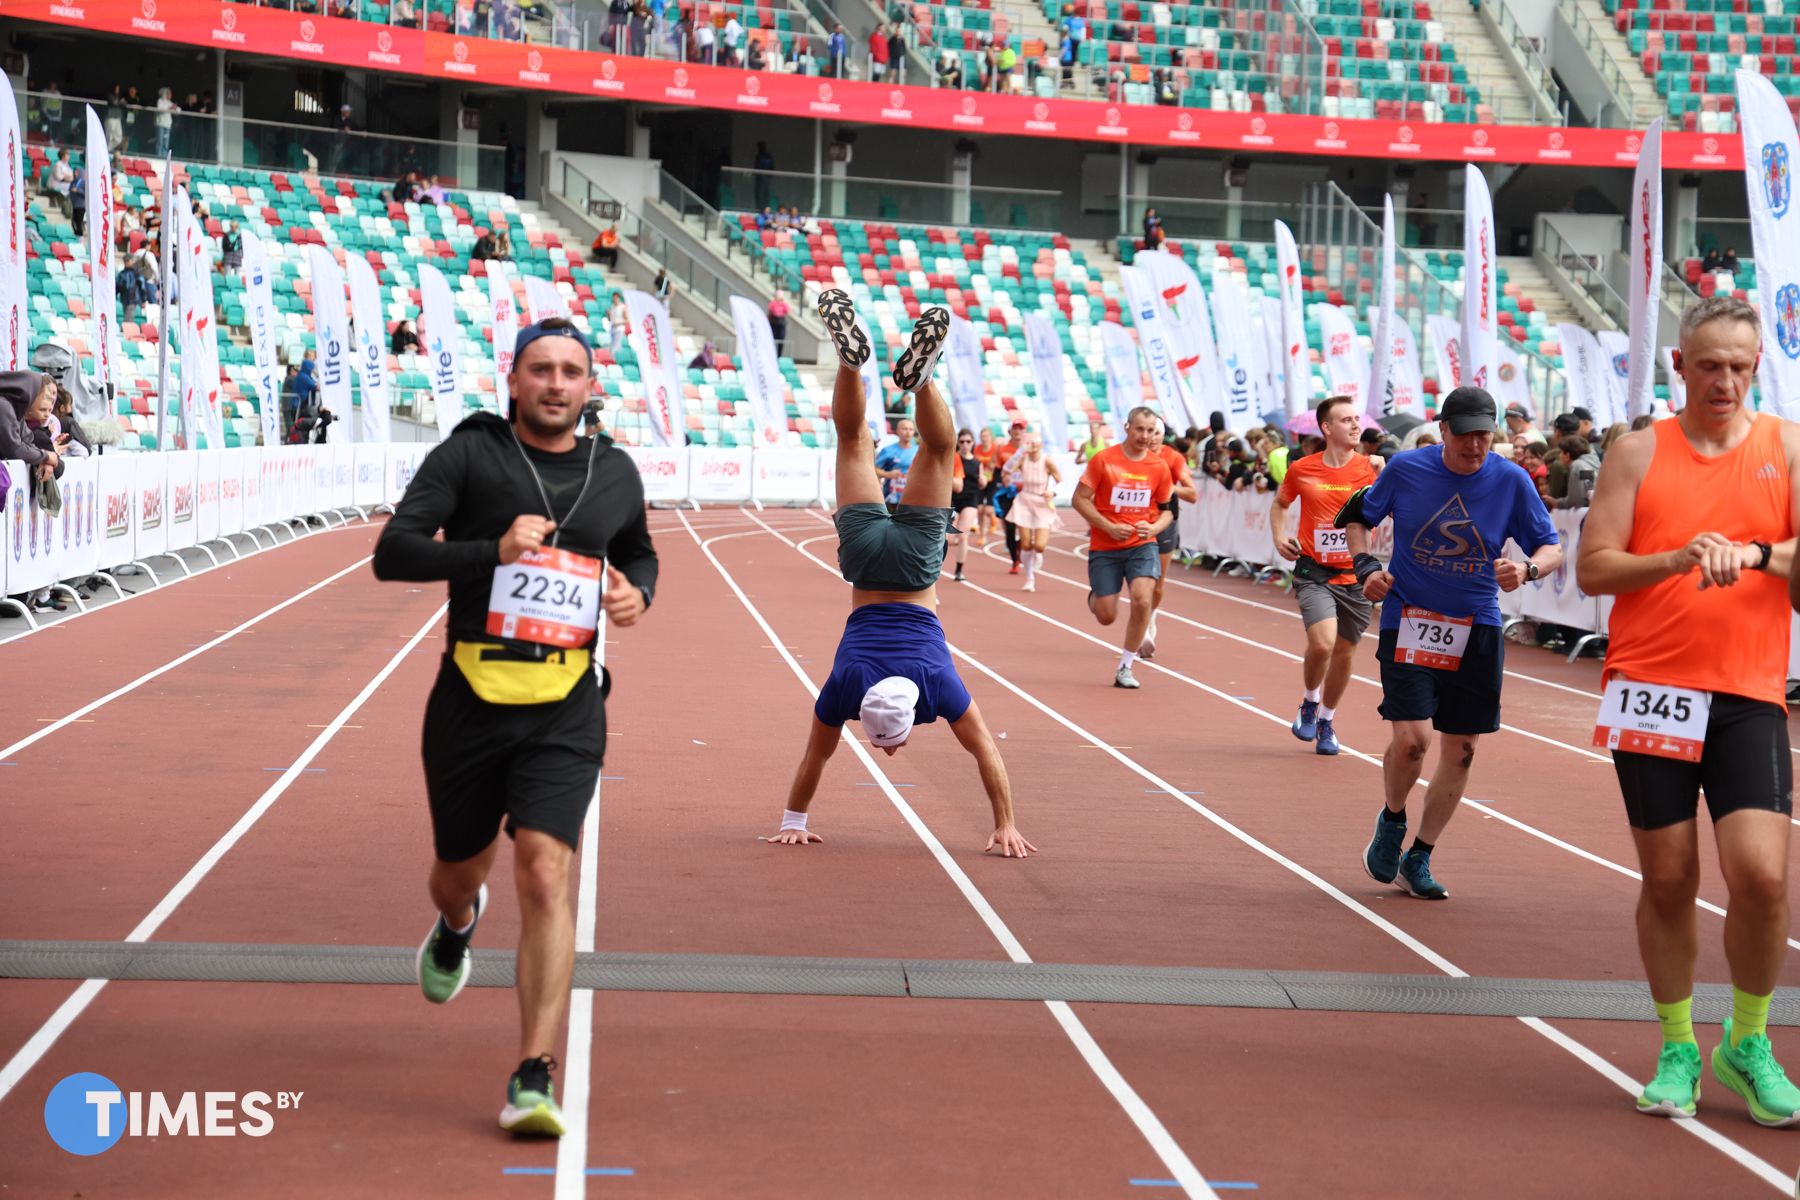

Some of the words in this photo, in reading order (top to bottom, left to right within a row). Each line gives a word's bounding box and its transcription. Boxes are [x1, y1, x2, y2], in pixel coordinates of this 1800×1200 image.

[212, 29, 245, 44] SYNERGETIC
[291, 41, 324, 54] SYNERGETIC
[325, 339, 341, 386] life
[367, 344, 381, 388] life
[437, 351, 455, 394] life
[1232, 369, 1247, 413] life
[1117, 491, 1145, 502] 4117
[1321, 532, 1347, 546] 299
[1413, 553, 1487, 576] SPIRIT
[510, 572, 583, 610] 2234
[519, 606, 571, 620] АЛЕКСАНДР
[1417, 622, 1454, 645] 736
[1620, 688, 1692, 722] 1345
[1638, 722, 1660, 731] ОЛЕГ
